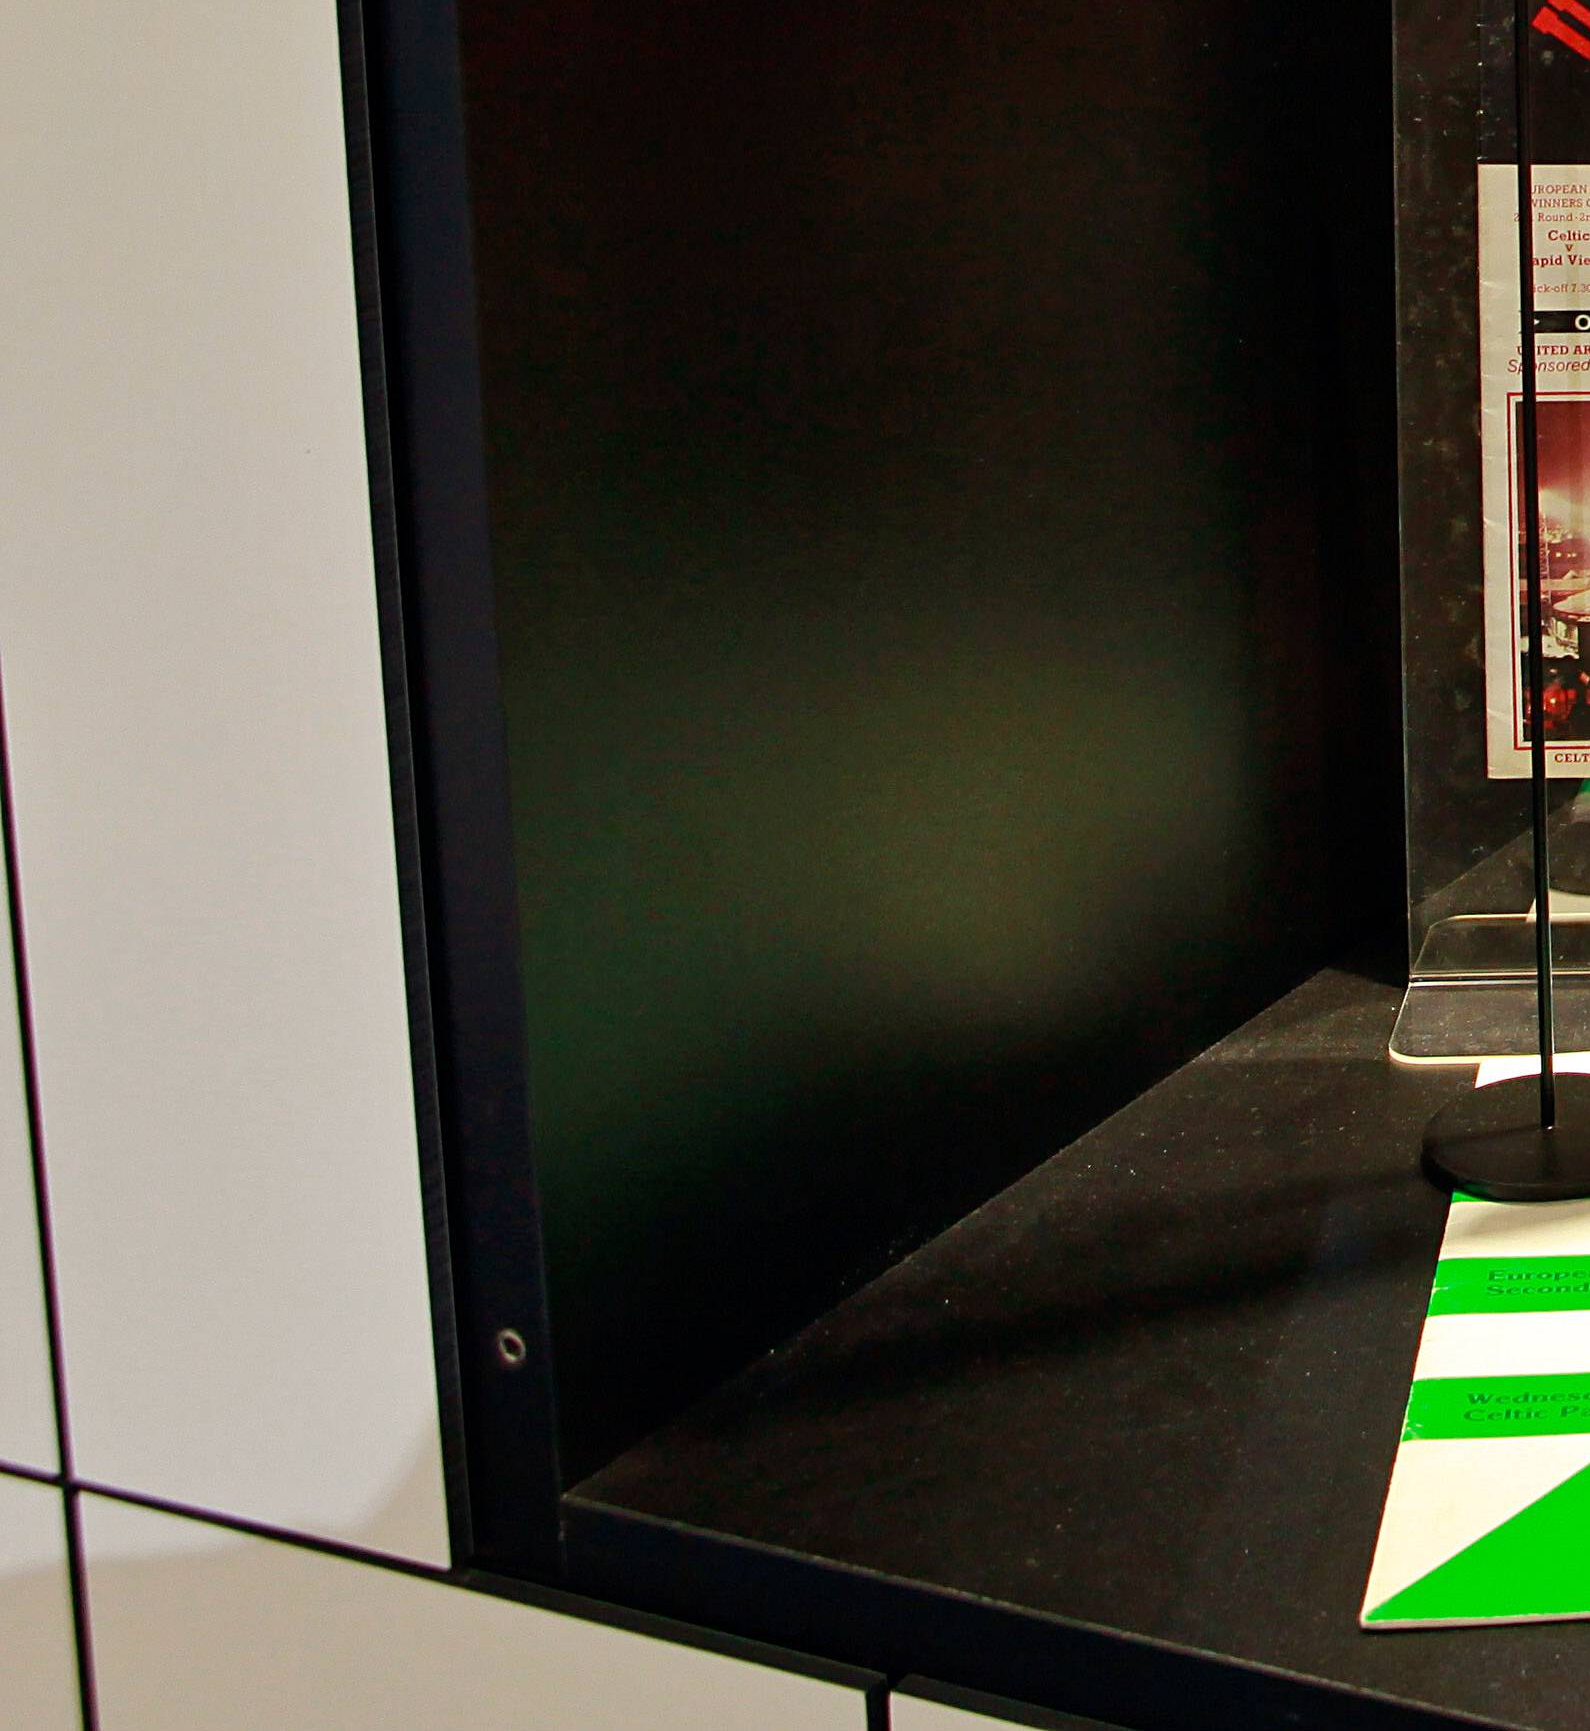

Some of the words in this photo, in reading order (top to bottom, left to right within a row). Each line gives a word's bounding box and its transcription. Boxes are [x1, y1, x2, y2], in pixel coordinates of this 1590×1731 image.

[1530, 184, 1588, 195] UROPEAN
[1547, 229, 1590, 242] Celtic
[1531, 256, 1563, 268] apid
[1517, 345, 1569, 356] UITED
